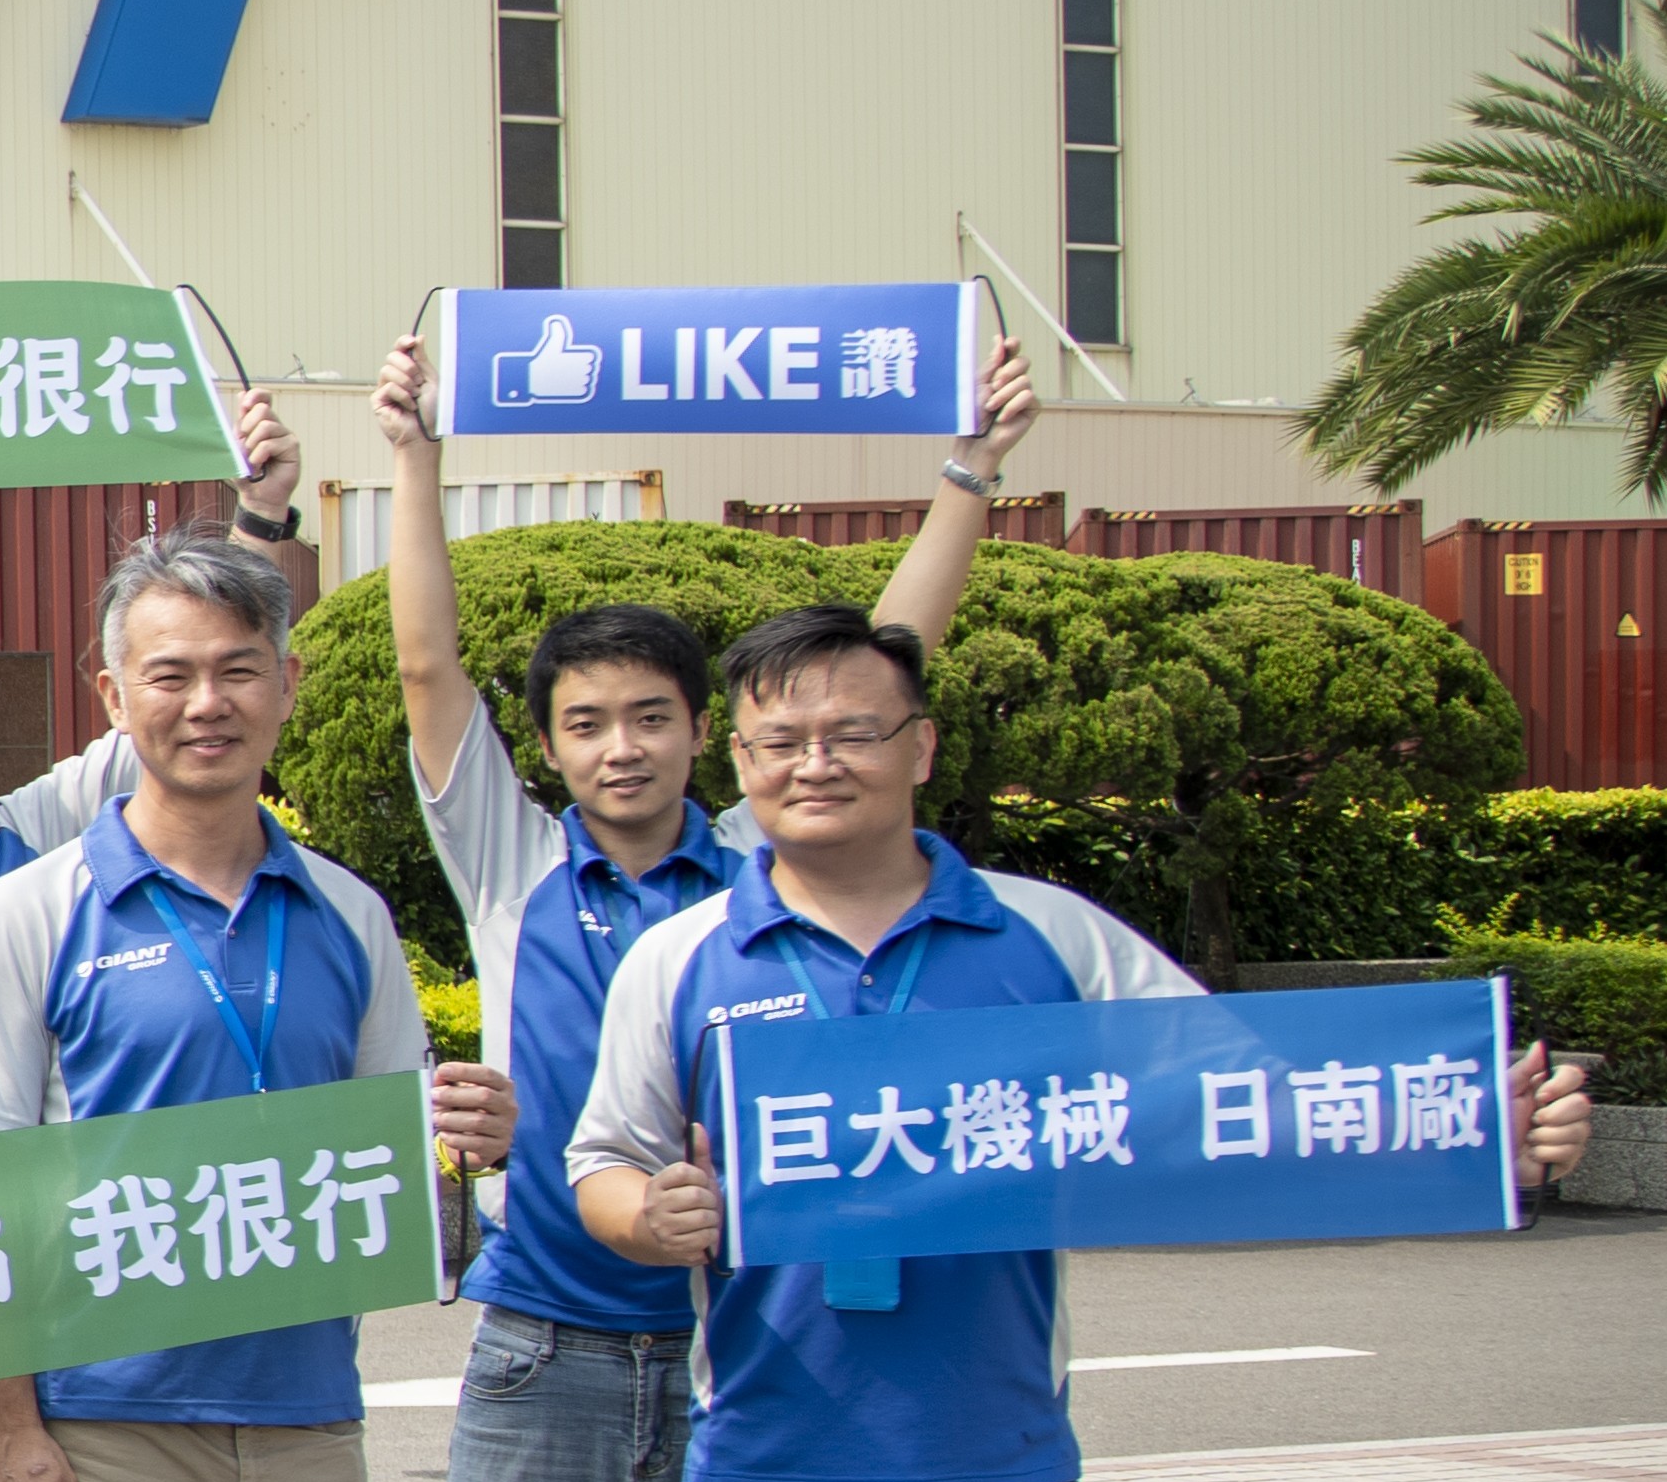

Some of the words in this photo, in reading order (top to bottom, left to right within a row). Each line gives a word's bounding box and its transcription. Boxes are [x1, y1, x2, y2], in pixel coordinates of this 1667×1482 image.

[620, 326, 821, 402] LIKE
[839, 326, 919, 400] 讚
[1351, 538, 1361, 584] BEA
[95, 942, 173, 970] GIANT
[126, 956, 167, 972] GROUP
[729, 992, 807, 1019] GIANT
[753, 1071, 1135, 1187] 巨大機械
[1197, 1052, 1485, 1162] 日南廠
[66, 1143, 400, 1298] 我很行
